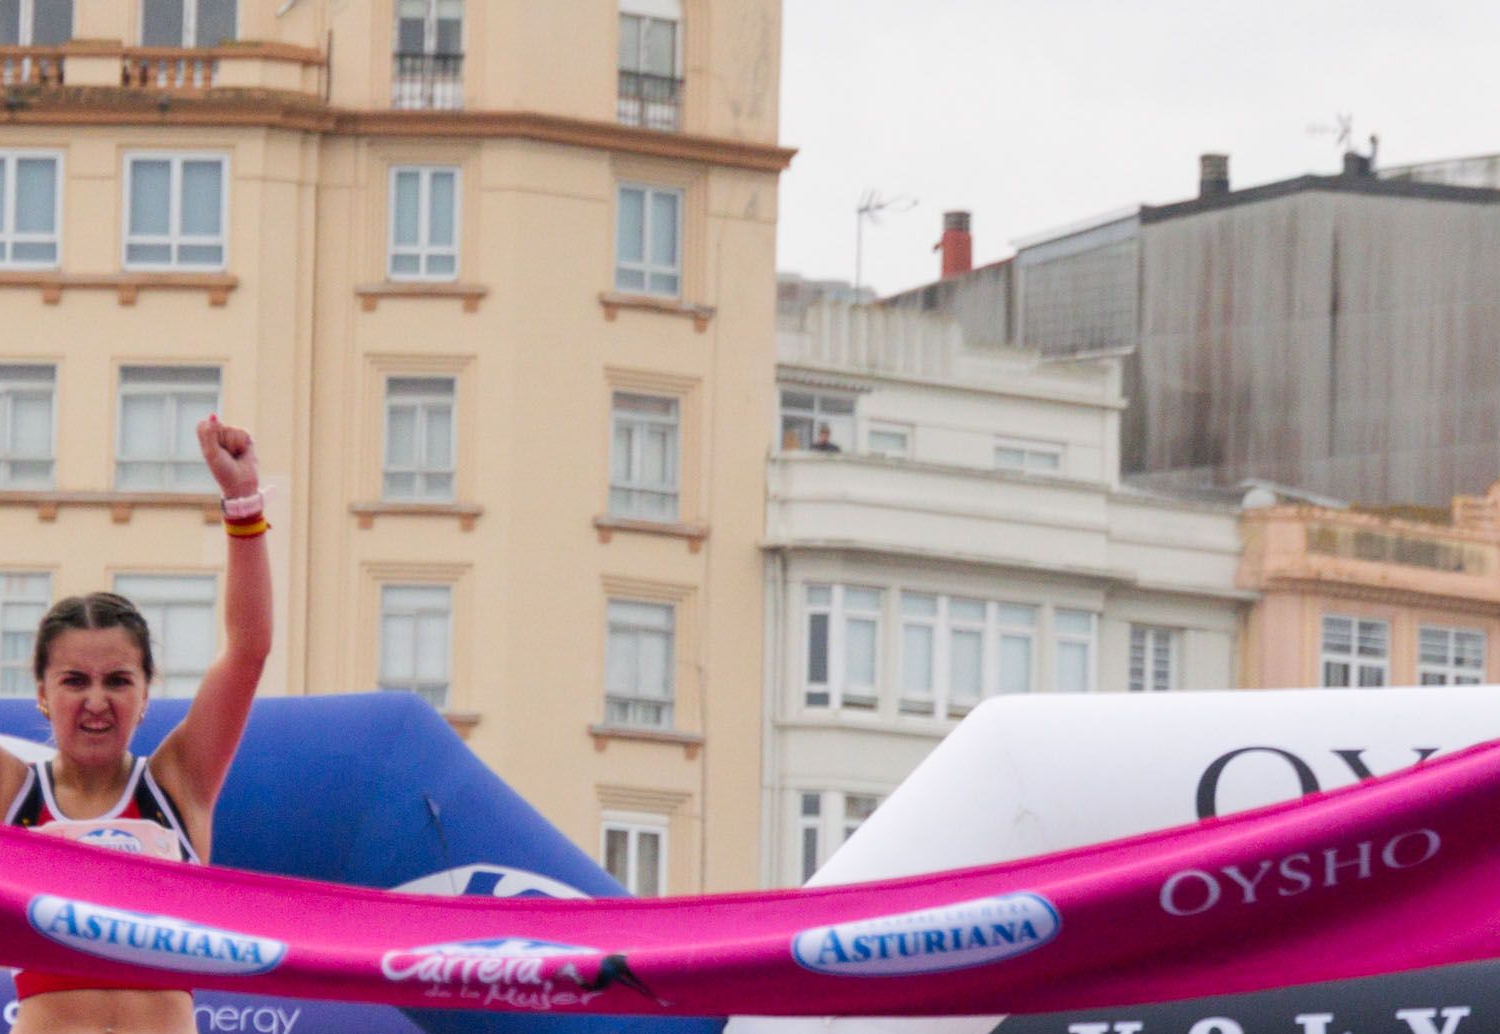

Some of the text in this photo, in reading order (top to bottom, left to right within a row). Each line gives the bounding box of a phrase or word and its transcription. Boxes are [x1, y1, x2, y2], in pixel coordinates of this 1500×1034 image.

[1159, 828, 1442, 916] OYSHO
[47, 903, 264, 964] ASTURIANA
[816, 919, 1039, 965] ASTURIANA
[381, 951, 544, 984] Carrera
